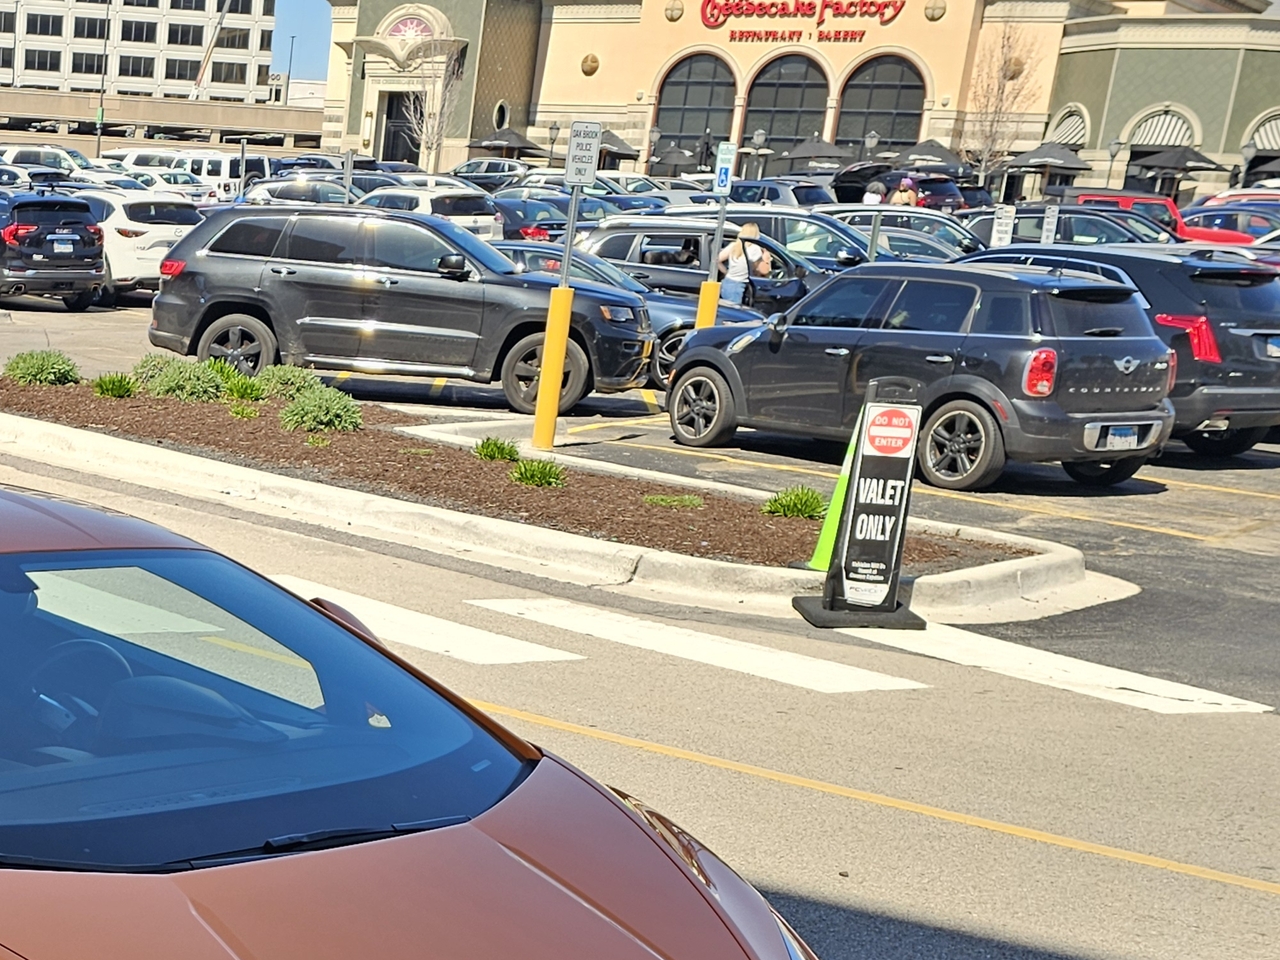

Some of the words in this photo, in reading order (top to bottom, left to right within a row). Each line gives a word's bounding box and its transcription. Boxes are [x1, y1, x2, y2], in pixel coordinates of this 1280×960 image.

[816, 0, 906, 28] Factory
[729, 30, 803, 42] RESTAURANT
[817, 30, 866, 42] BAKERY
[572, 129, 581, 138] OAK
[582, 130, 600, 139] BROOK
[575, 142, 593, 151] POLICE
[572, 155, 594, 164] VEHICLES
[574, 167, 587, 176] ONLY
[875, 416, 888, 425] DO
[892, 417, 910, 427] NOT
[875, 437, 904, 447] ENTER
[859, 478, 905, 505] VALET
[855, 513, 896, 541] ONLY
